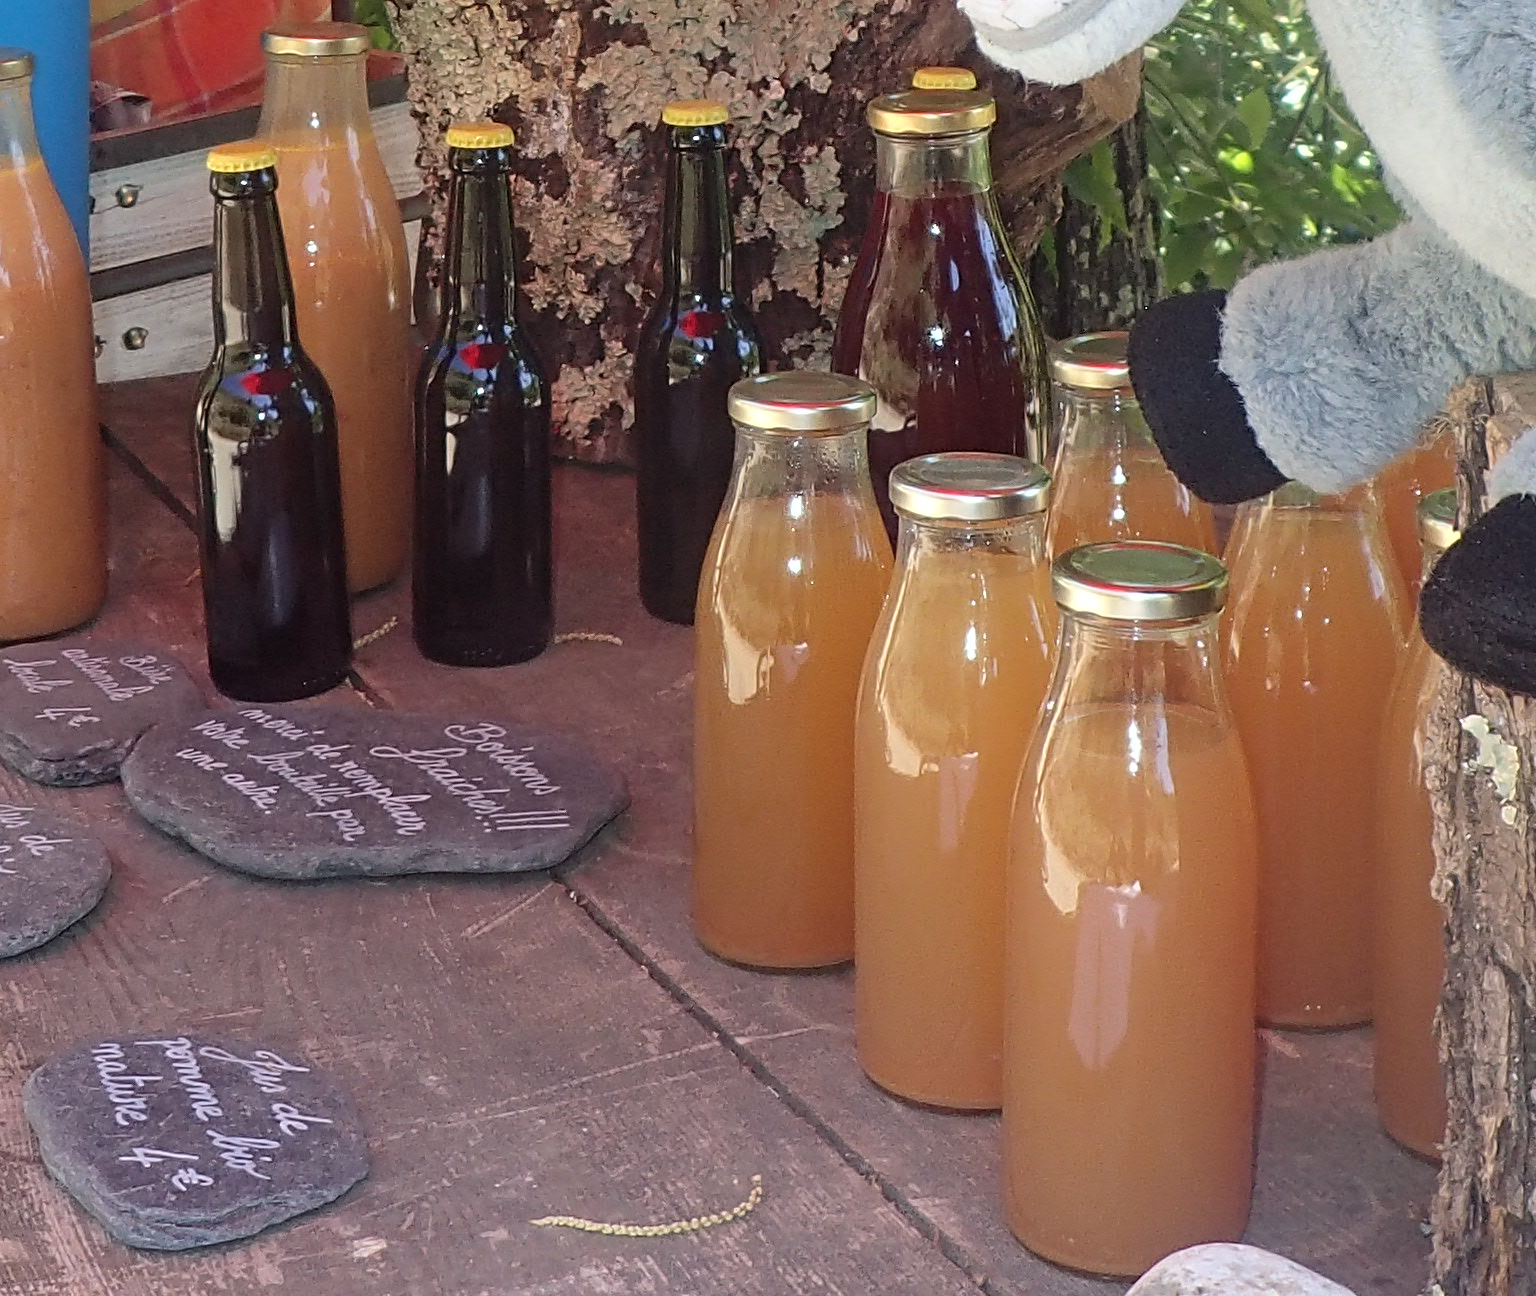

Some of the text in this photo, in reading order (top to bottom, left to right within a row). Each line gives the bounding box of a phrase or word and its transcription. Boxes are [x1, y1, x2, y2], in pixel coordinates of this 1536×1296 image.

[3, 658, 74, 694] locale
[61, 648, 154, 702] artisanale
[176, 748, 228, 771] une
[306, 743, 356, 760] de
[444, 722, 561, 796] Boissons
[246, 751, 353, 807] bouteille
[305, 808, 366, 842] par
[330, 760, 433, 836] remplacer
[18, 834, 73, 856] de
[92, 1042, 164, 1126] nature
[133, 1036, 281, 1181] pomme bio
[199, 1047, 334, 1136] Jus de
